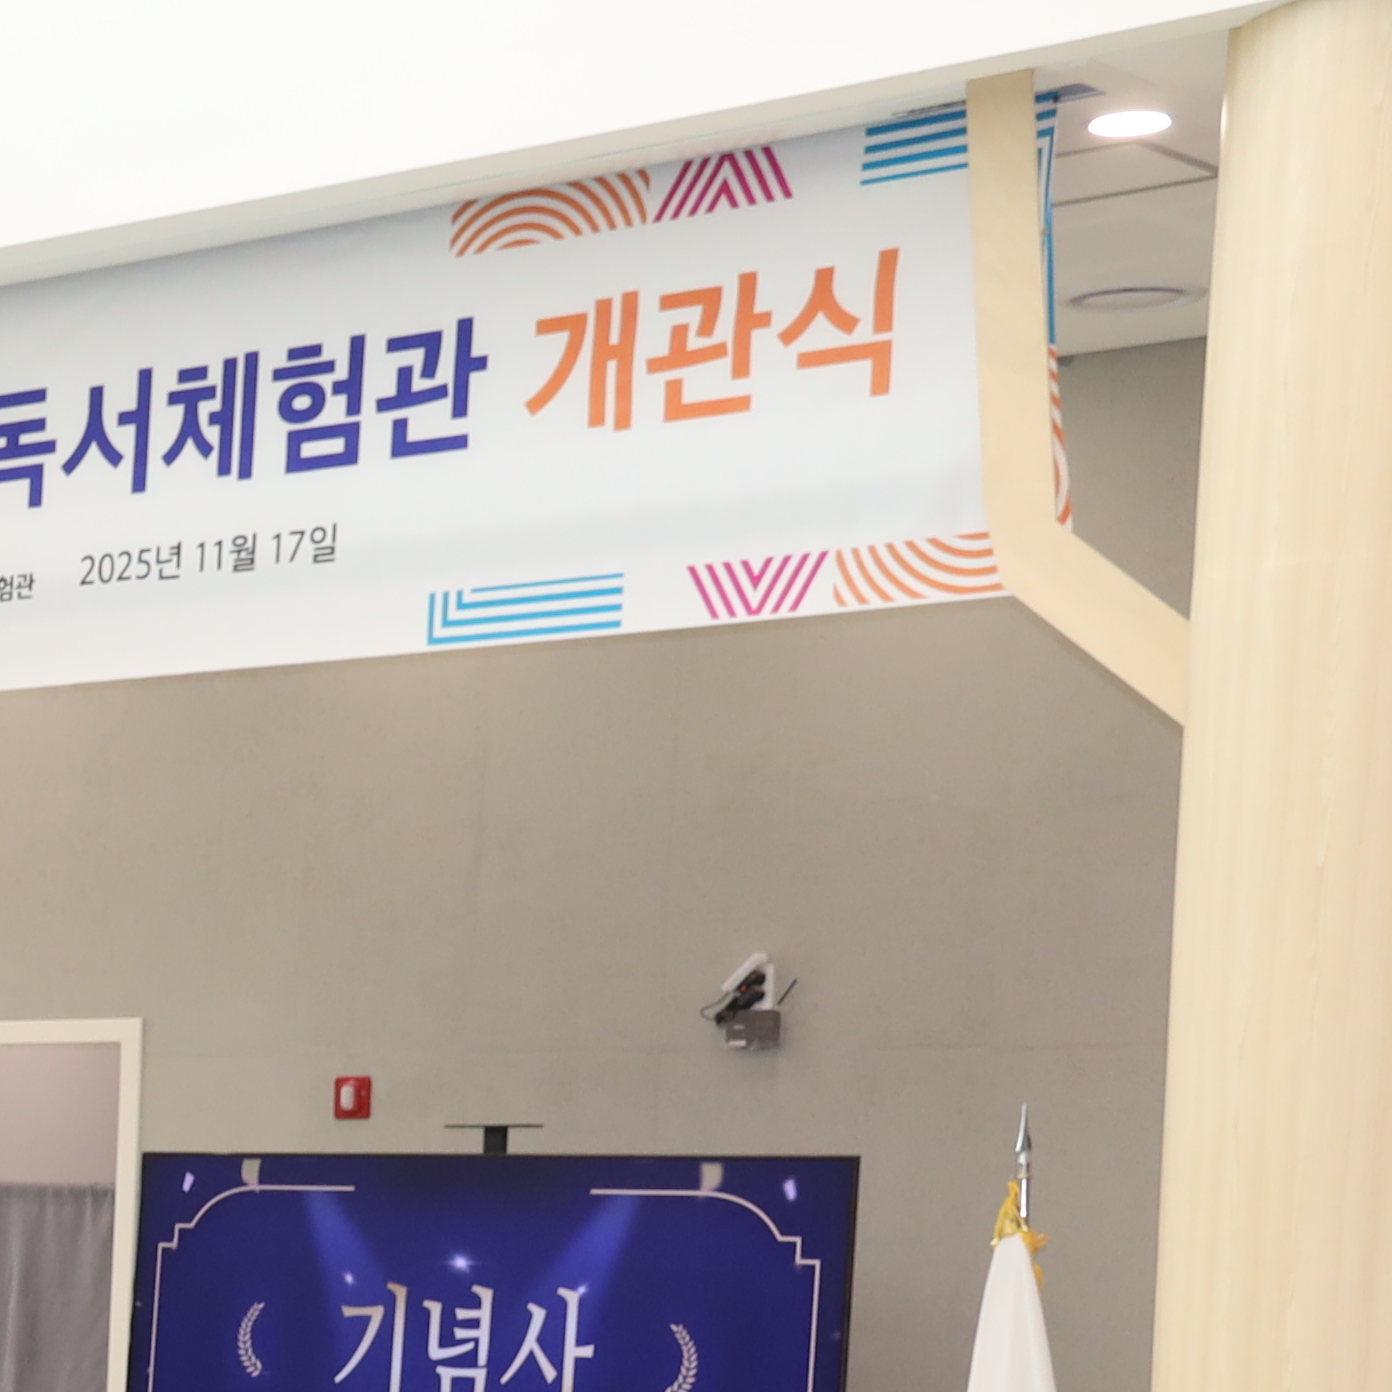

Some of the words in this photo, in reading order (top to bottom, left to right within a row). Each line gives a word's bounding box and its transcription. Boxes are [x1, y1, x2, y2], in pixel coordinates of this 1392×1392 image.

[524, 249, 902, 432] 개관식
[79, 541, 182, 586] 2025년
[195, 532, 257, 573] 11월
[272, 523, 338, 565] 17일
